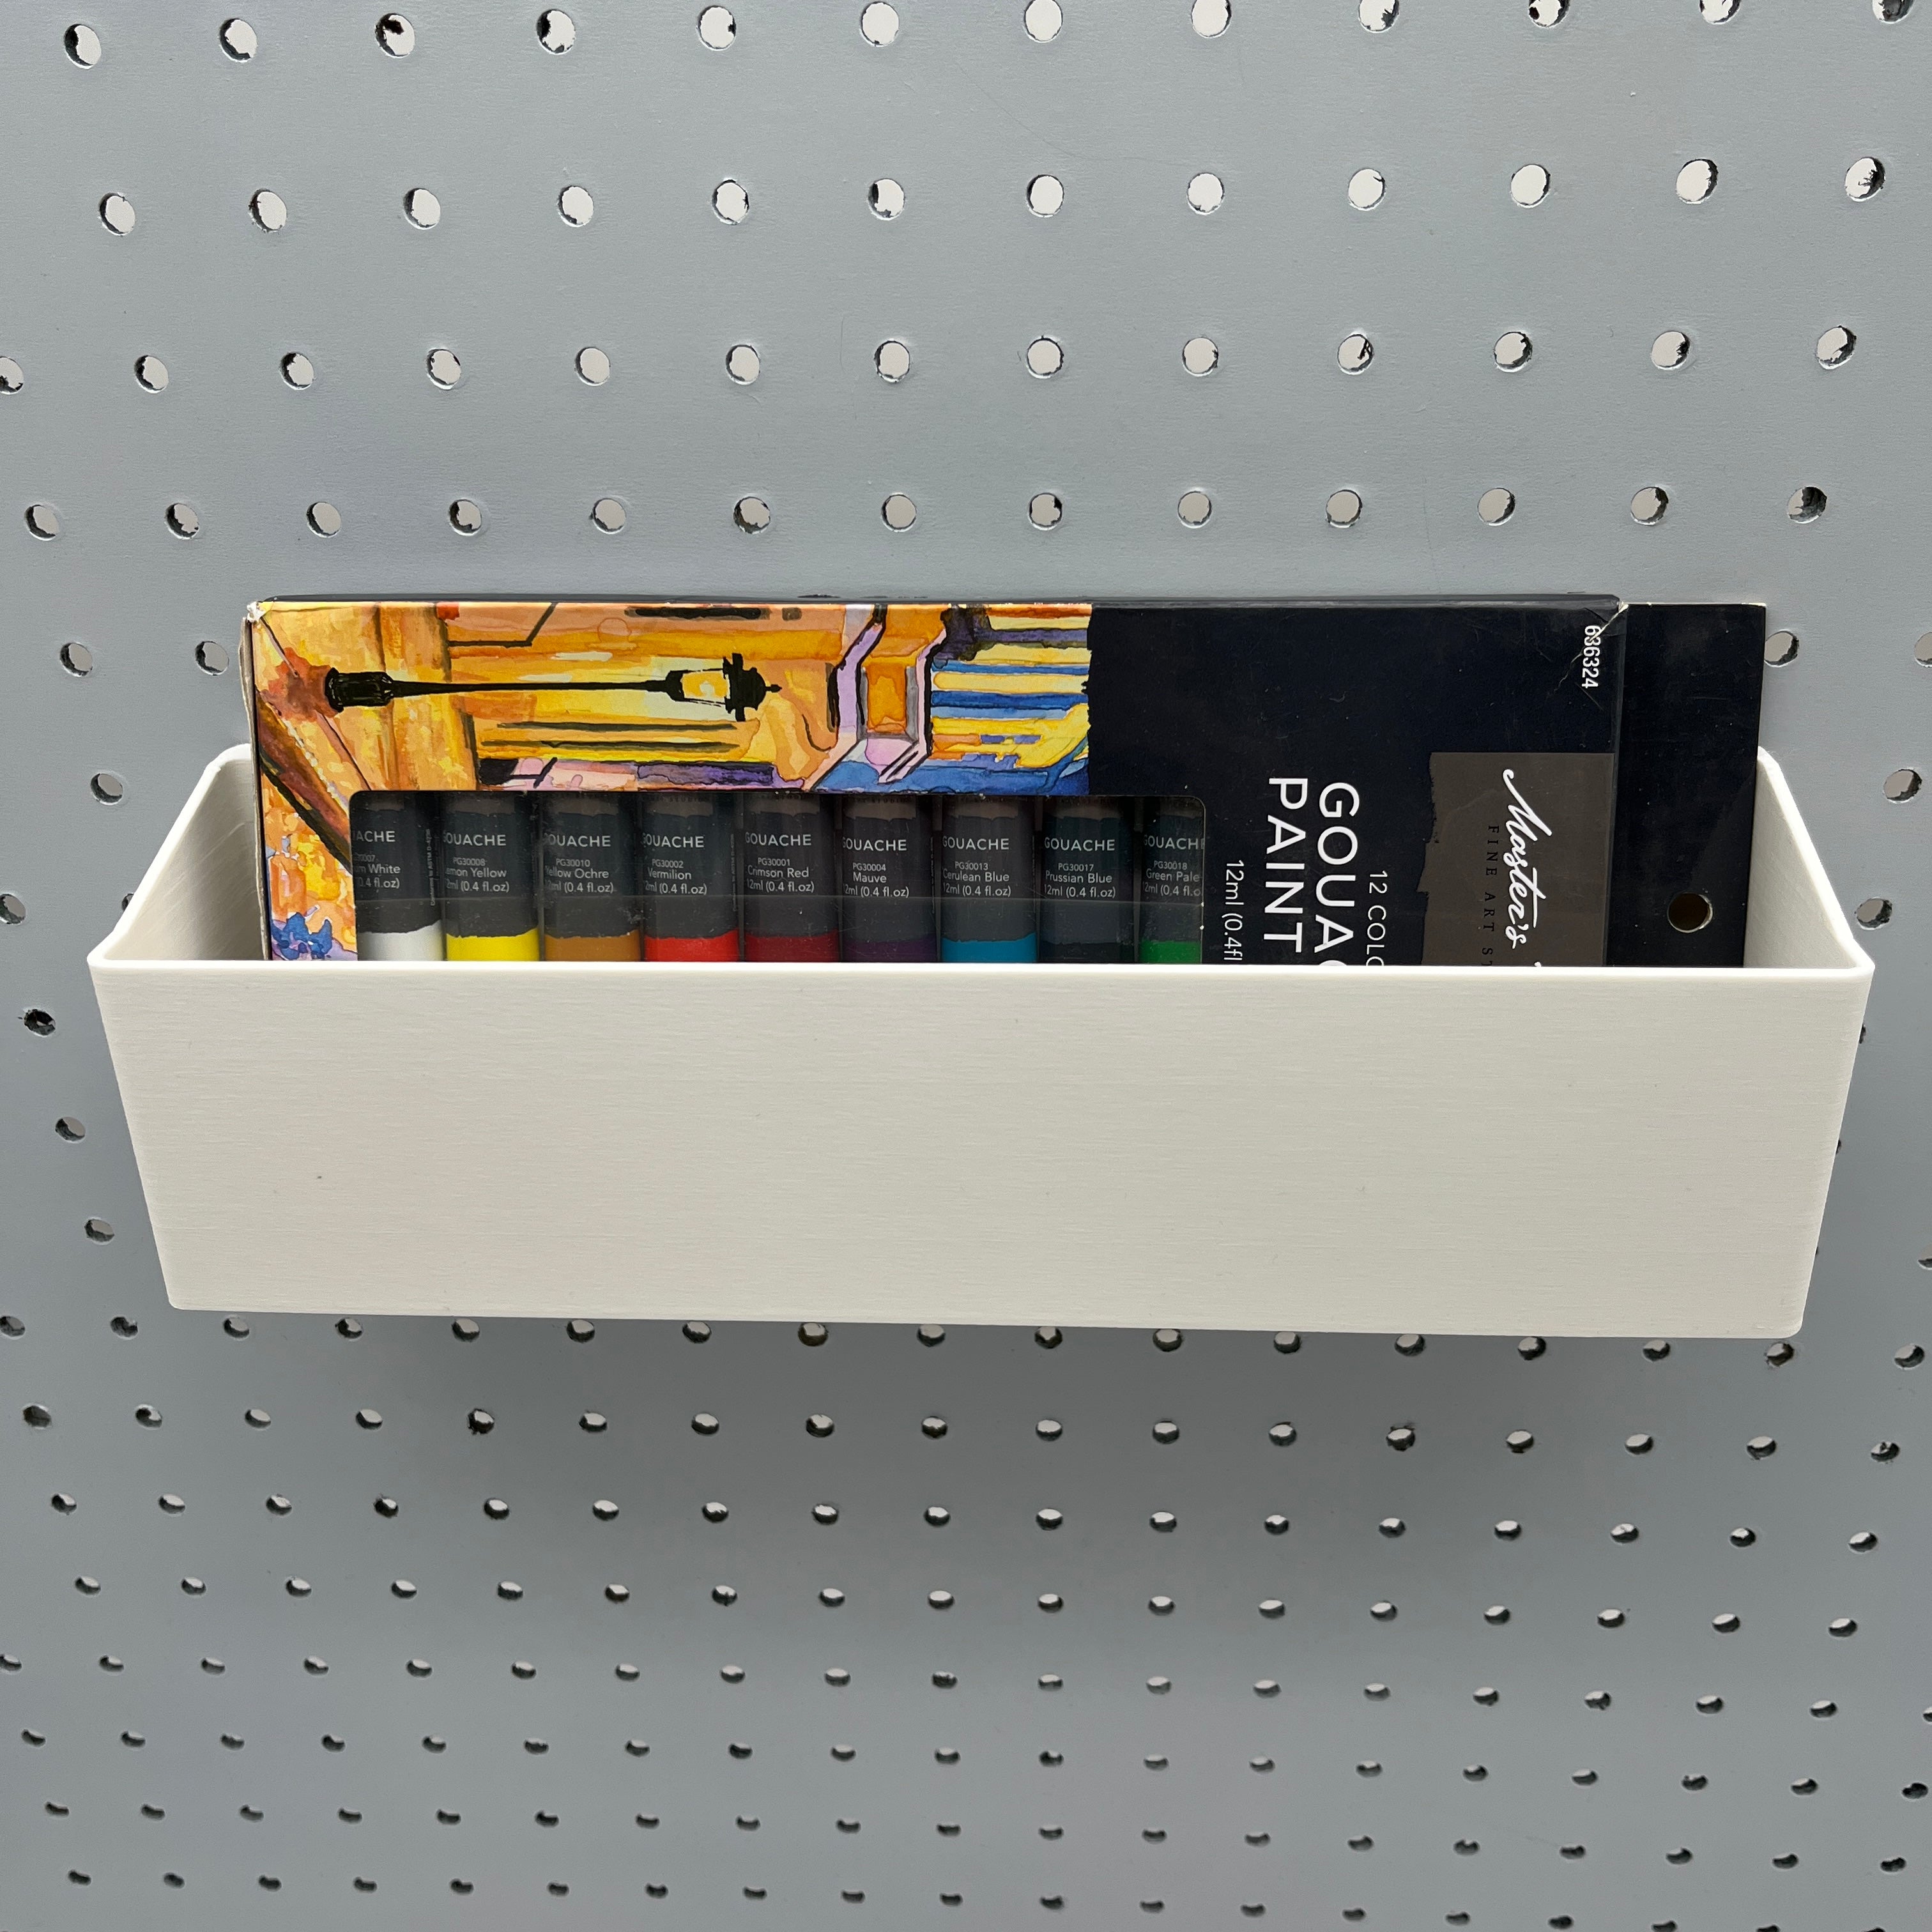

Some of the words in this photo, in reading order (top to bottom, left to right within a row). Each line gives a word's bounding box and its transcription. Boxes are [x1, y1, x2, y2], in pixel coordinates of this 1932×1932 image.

[1581, 625, 1601, 689] 636324
[353, 831, 395, 842] ACHE
[745, 832, 811, 847] GOUACHE
[942, 836, 1009, 850] GOUACHE
[1044, 837, 1116, 852] GOUACHE
[1485, 825, 1499, 876] FINE
[556, 858, 590, 867] PG30010
[652, 859, 684, 869] PG30002
[758, 857, 790, 866] PG30001
[1154, 860, 1188, 870] PG30018
[1263, 778, 1308, 953] PAINT
[1502, 769, 1552, 949] Master's
[368, 864, 401, 874] White
[470, 867, 507, 878] Yellow
[545, 866, 572, 878] Yellow
[575, 868, 609, 878] Ochre
[747, 865, 783, 878] Crimson
[787, 866, 809, 878] Red
[852, 862, 886, 872] PG30004
[954, 861, 988, 871] PG30013
[1058, 862, 1094, 872] PG30017
[647, 867, 692, 880] Vermilion
[853, 871, 887, 883] Mauve
[942, 868, 981, 882] Cerulean
[985, 871, 1009, 882] Blue
[1045, 870, 1084, 884] Prussian
[1087, 873, 1113, 884] Blue
[1146, 868, 1172, 881] Green
[1176, 871, 1200, 882] Pale
[1314, 782, 1360, 966] GOUA
[461, 880, 479, 893] (0.4
[482, 880, 510, 893] fl.oz)
[564, 882, 583, 894] (0.4
[586, 882, 614, 894] fl.oz)
[746, 878, 763, 891] 12ml
[766, 881, 785, 893] (0.4
[788, 880, 815, 893] fl.oz)
[1225, 859, 1245, 905] 12ml
[1368, 870, 1388, 894] 12
[659, 883, 678, 895] (0.4
[680, 883, 707, 896] fl.oz)
[861, 886, 880, 898] (0.4
[883, 886, 910, 898] fl.oz)
[942, 882, 960, 894] 12ml
[962, 885, 981, 898] (0.4
[985, 885, 1011, 898] fl.oz)
[1044, 884, 1063, 896] 12ml
[1066, 886, 1087, 898] (0.4
[1089, 886, 1116, 899] fl.oz)
[1160, 884, 1179, 896] (0.4
[1483, 892, 1496, 931] ART
[1221, 912, 1244, 961] (0.4fl
